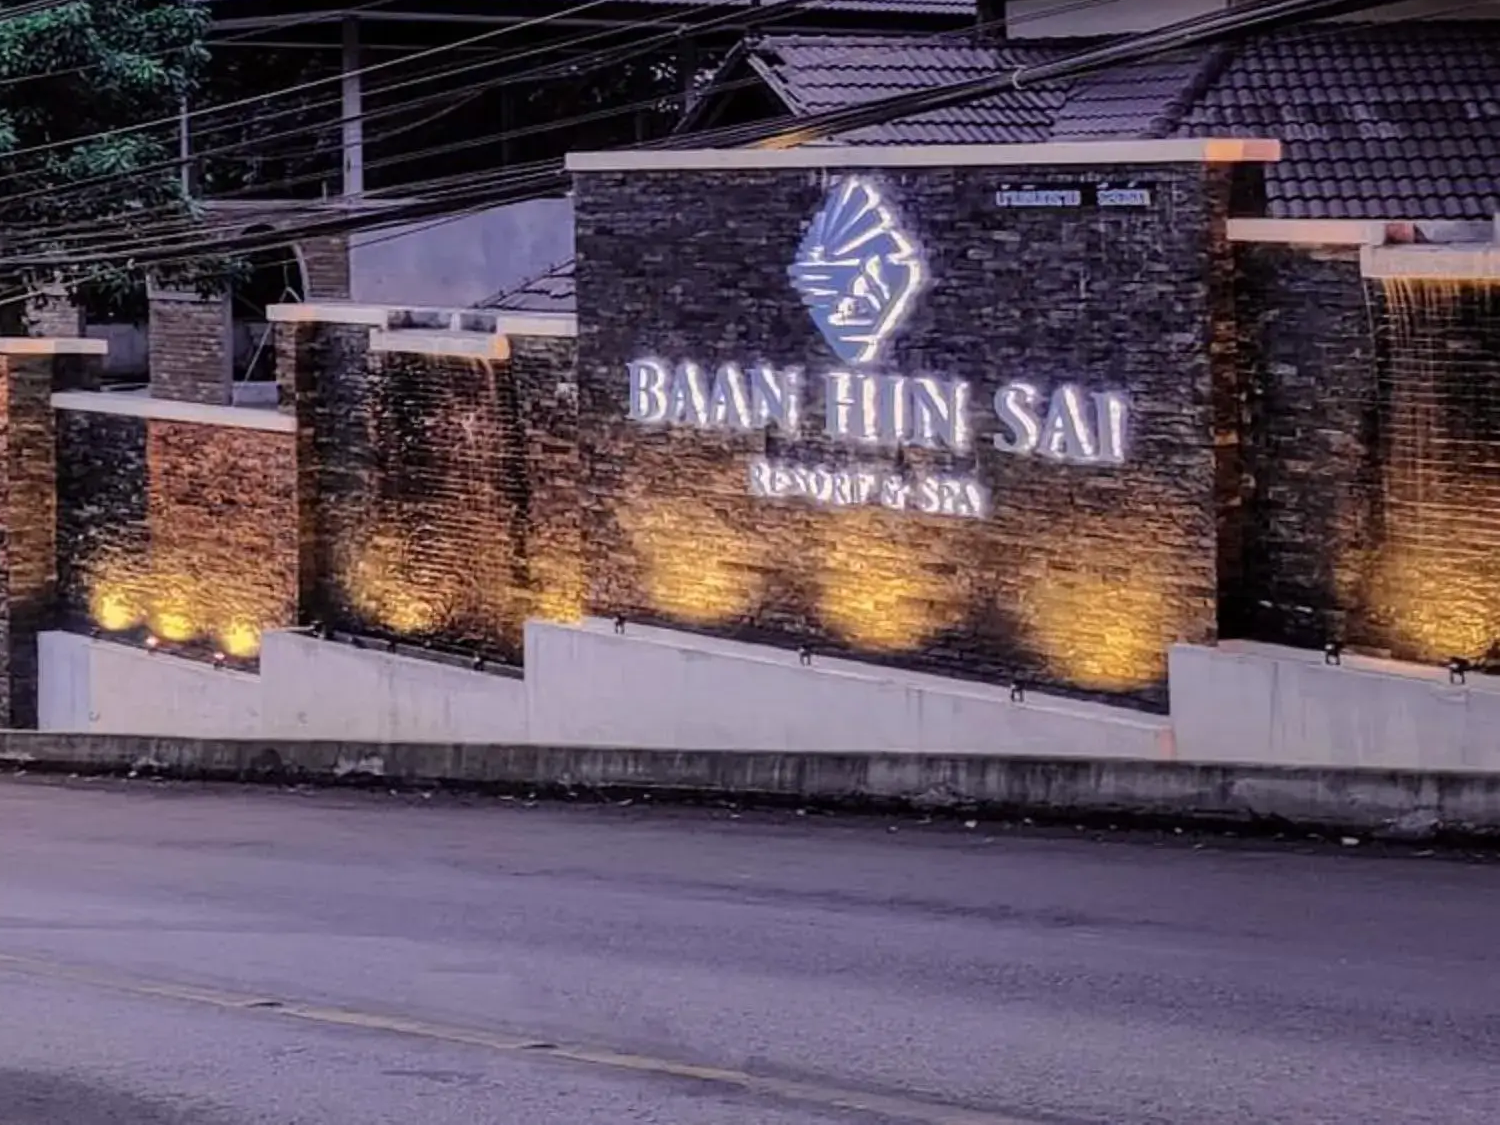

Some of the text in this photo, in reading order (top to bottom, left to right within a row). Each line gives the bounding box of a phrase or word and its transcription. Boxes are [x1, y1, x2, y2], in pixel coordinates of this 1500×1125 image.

[627, 358, 1127, 464] BAAN HIN SAI
[881, 475, 910, 509] &
[918, 476, 986, 518] SPA
